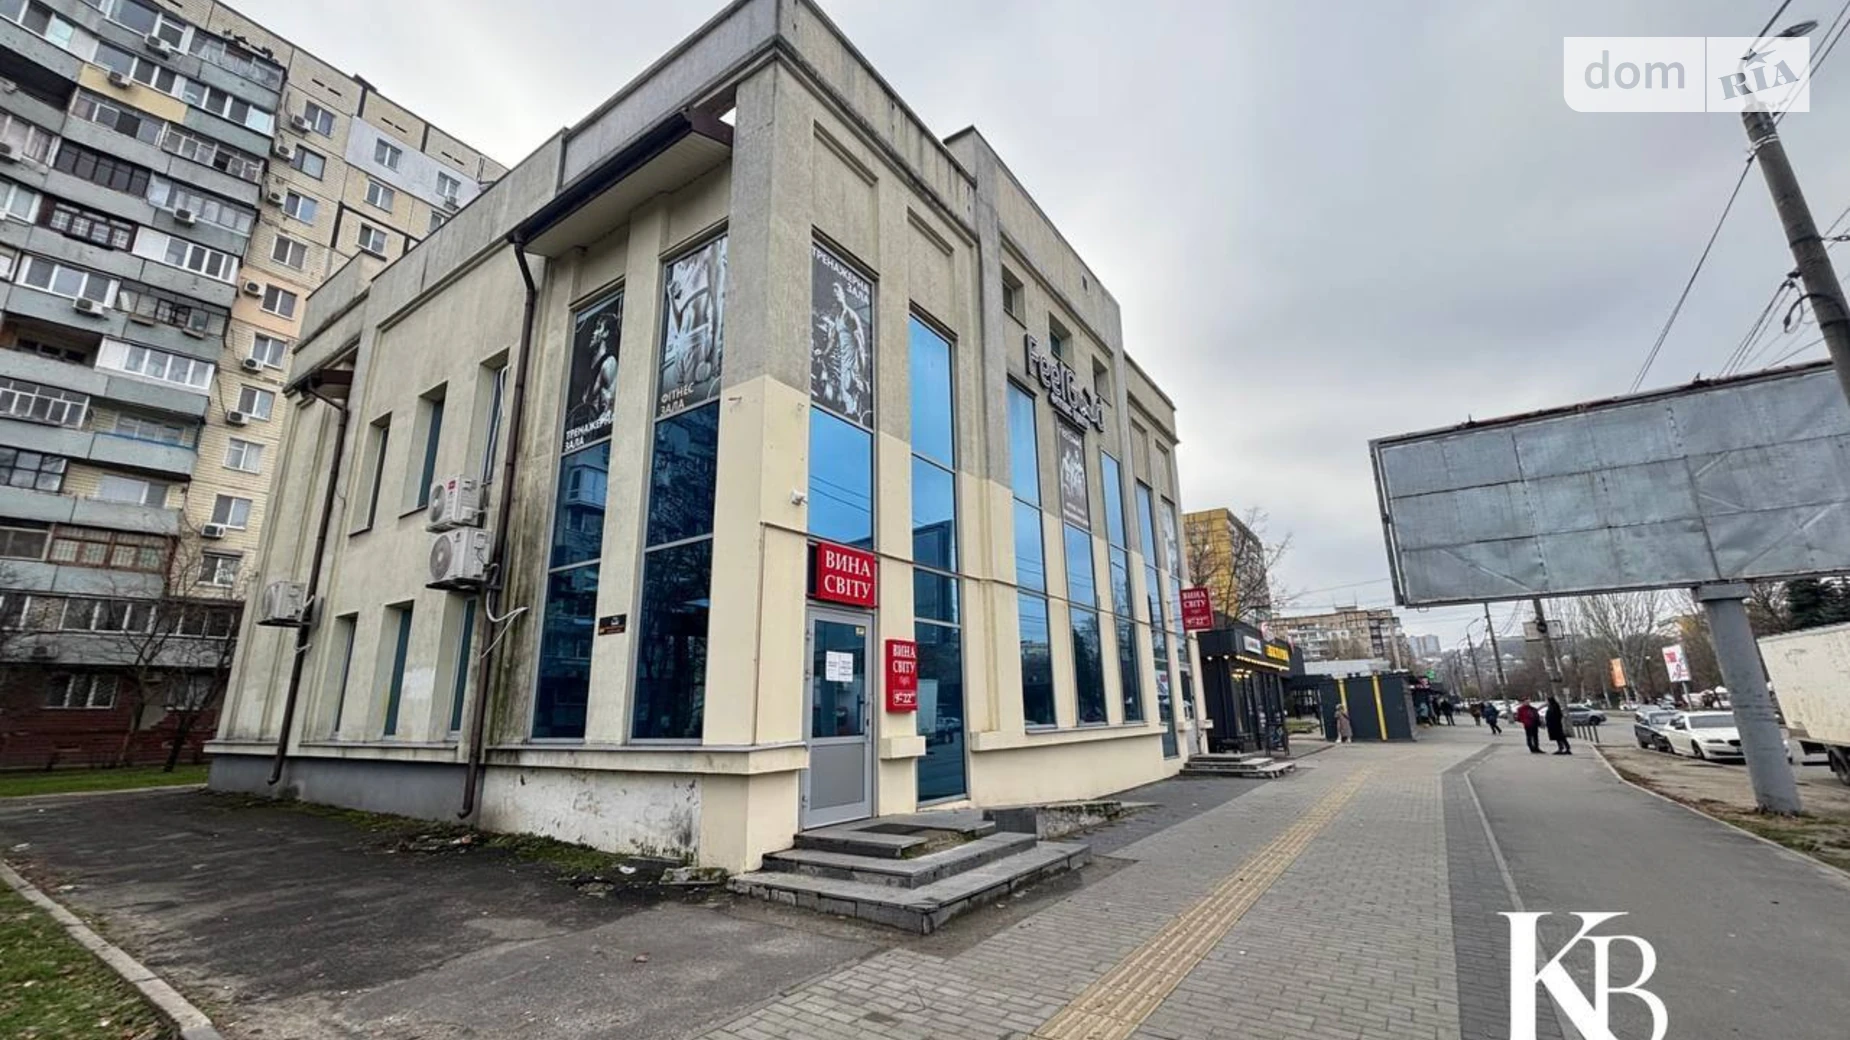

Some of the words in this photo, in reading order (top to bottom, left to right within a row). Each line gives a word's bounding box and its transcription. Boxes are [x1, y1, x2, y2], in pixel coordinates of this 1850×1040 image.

[846, 282, 870, 306] ЗАЛА
[660, 383, 695, 404] ФІТНЕС
[660, 400, 685, 416] ЗАЛА
[564, 437, 585, 452] ЗАЛА
[825, 550, 871, 578] ВИНА
[824, 575, 871, 599] СВІТУ
[892, 644, 916, 658] ВИНА
[892, 660, 916, 674] СВІТУ
